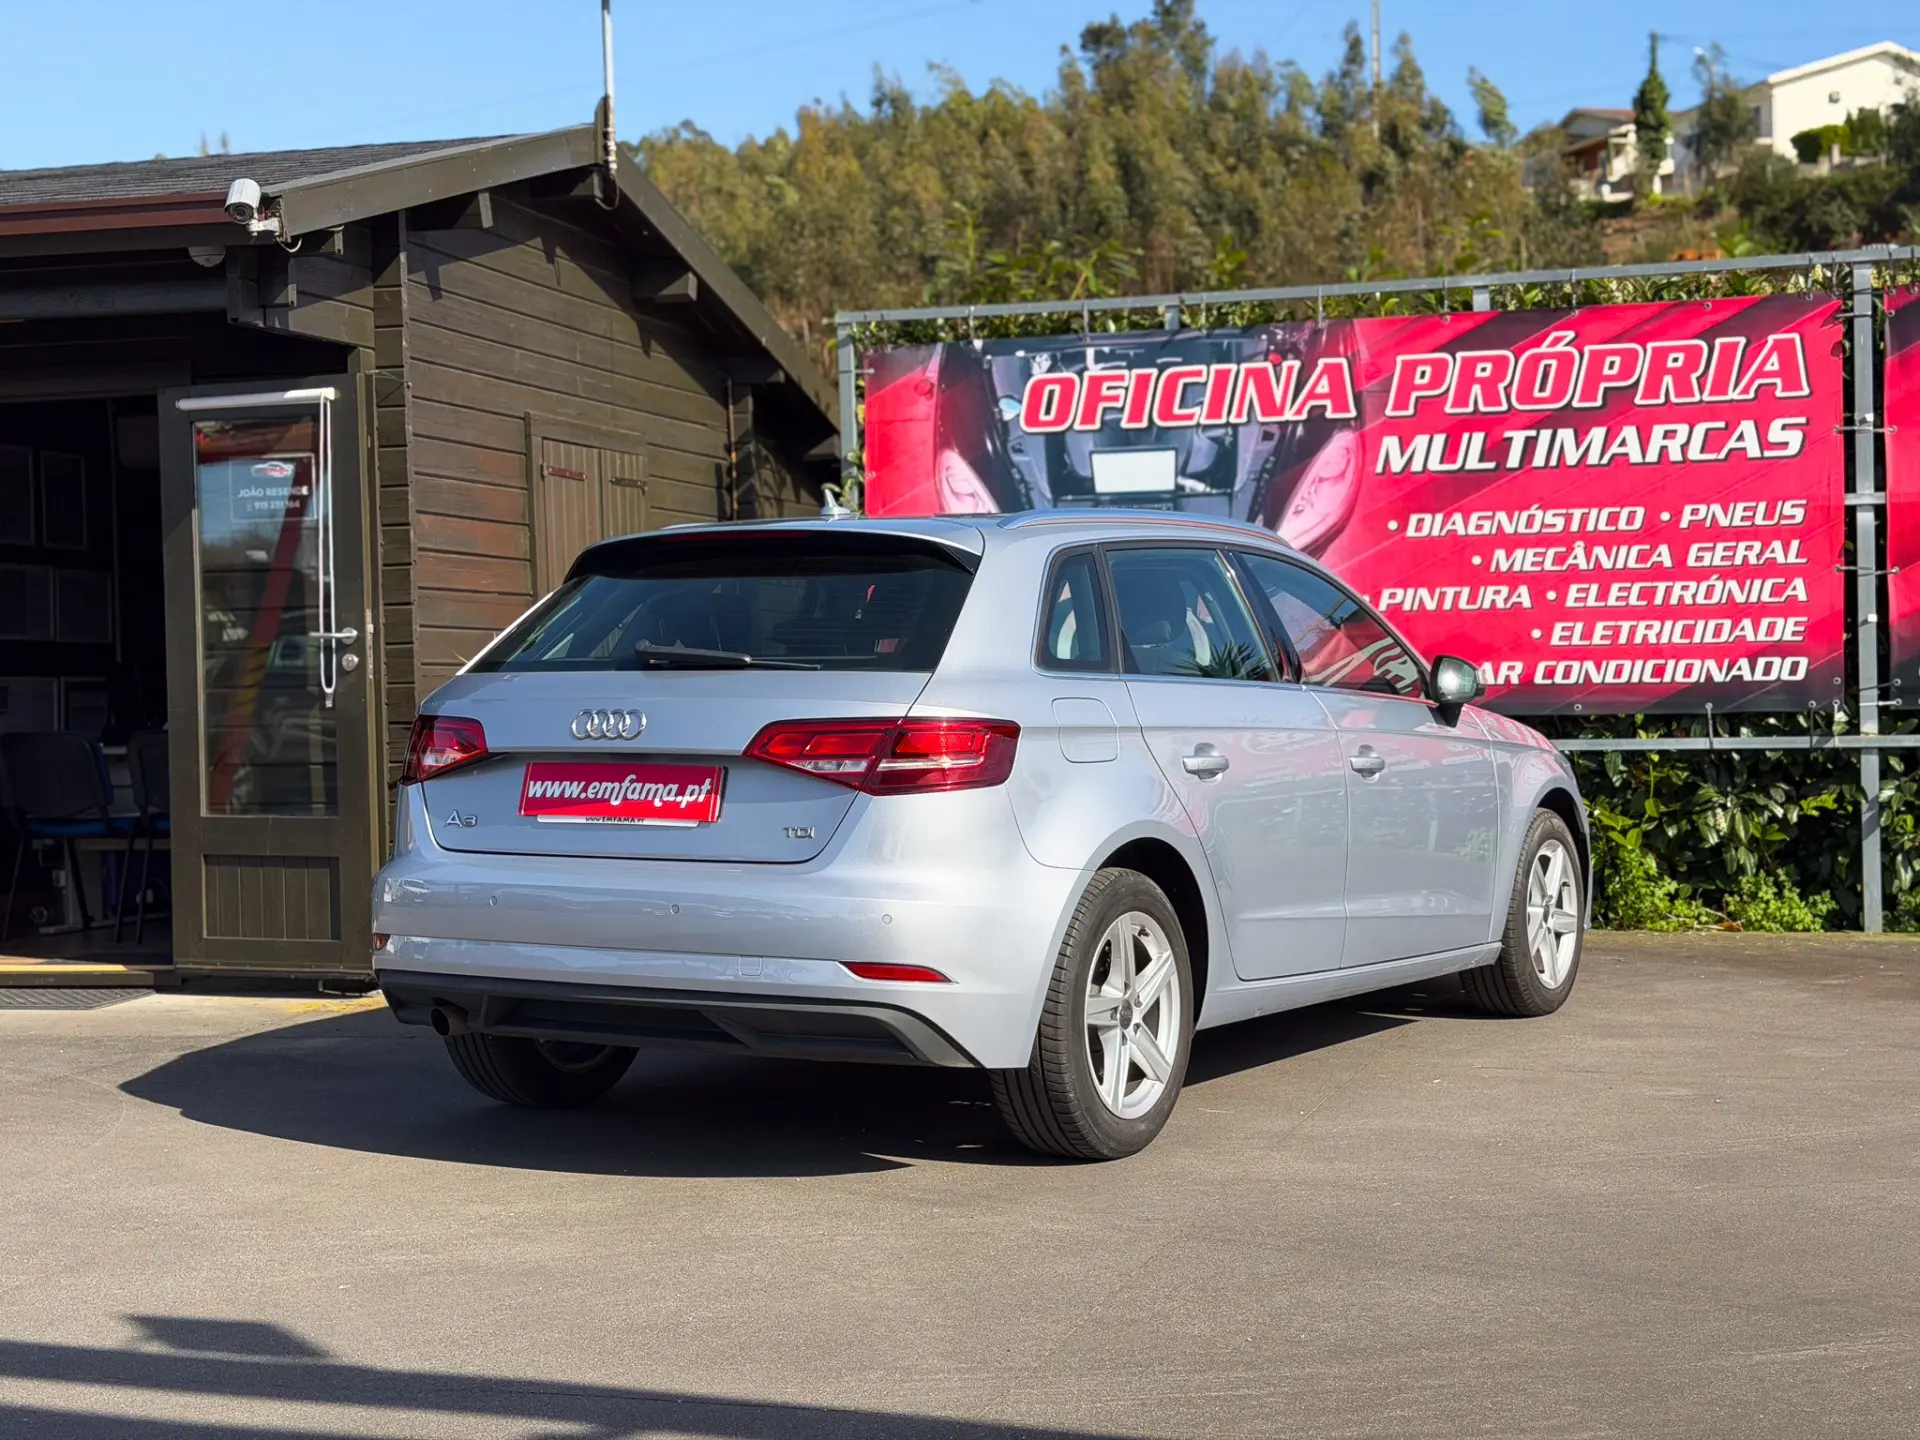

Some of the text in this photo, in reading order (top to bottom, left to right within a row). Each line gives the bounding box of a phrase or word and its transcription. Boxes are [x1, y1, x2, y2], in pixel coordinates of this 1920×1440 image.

[1018, 330, 1810, 437] OFICINA PRÓPRIA
[1375, 416, 1807, 475] MULTIMARCAS
[1405, 499, 1807, 538] DIAGNÓSTICO PNEUS
[1490, 540, 1807, 572] MECÂNICA GERAL
[1377, 574, 1808, 612] PINTURA ELECTRÓNICA
[1550, 616, 1808, 646] ELETRICIDADE
[1533, 656, 1809, 685] CONDICIONADO
[527, 774, 711, 809] www.emfama.pt
[443, 809, 478, 828] A3
[782, 826, 816, 839] TDI
